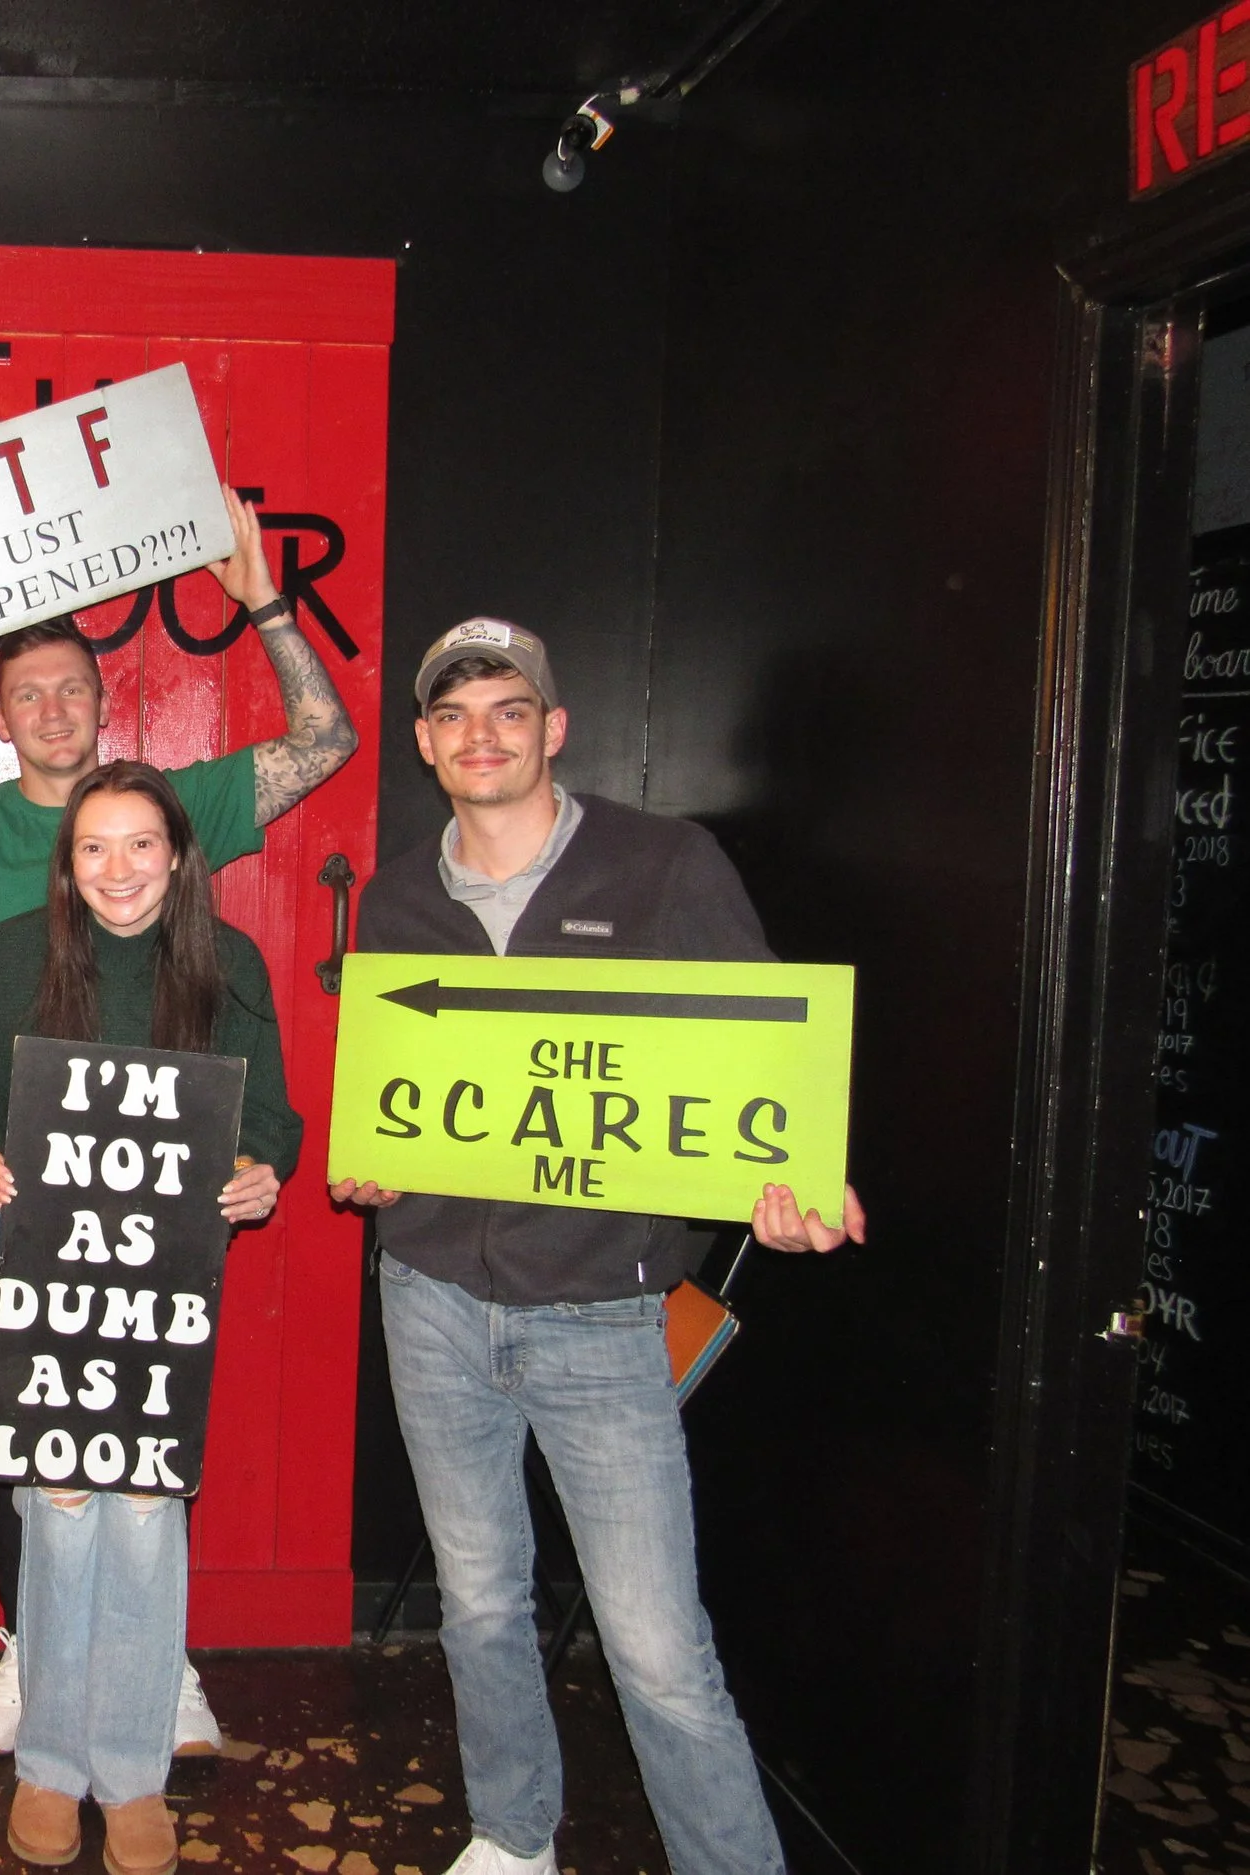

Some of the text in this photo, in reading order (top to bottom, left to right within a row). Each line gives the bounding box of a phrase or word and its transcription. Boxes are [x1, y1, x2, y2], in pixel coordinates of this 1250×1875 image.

[450, 634, 501, 647] MICHELIN
[573, 923, 610, 933] Columbia
[528, 1039, 624, 1081] SHE
[61, 1058, 180, 1119] I'M
[376, 1078, 789, 1164] SCARES
[41, 1132, 190, 1195] NOT
[533, 1155, 606, 1198] ME
[58, 1210, 155, 1266] AS
[18, 1355, 171, 1415] AS I
